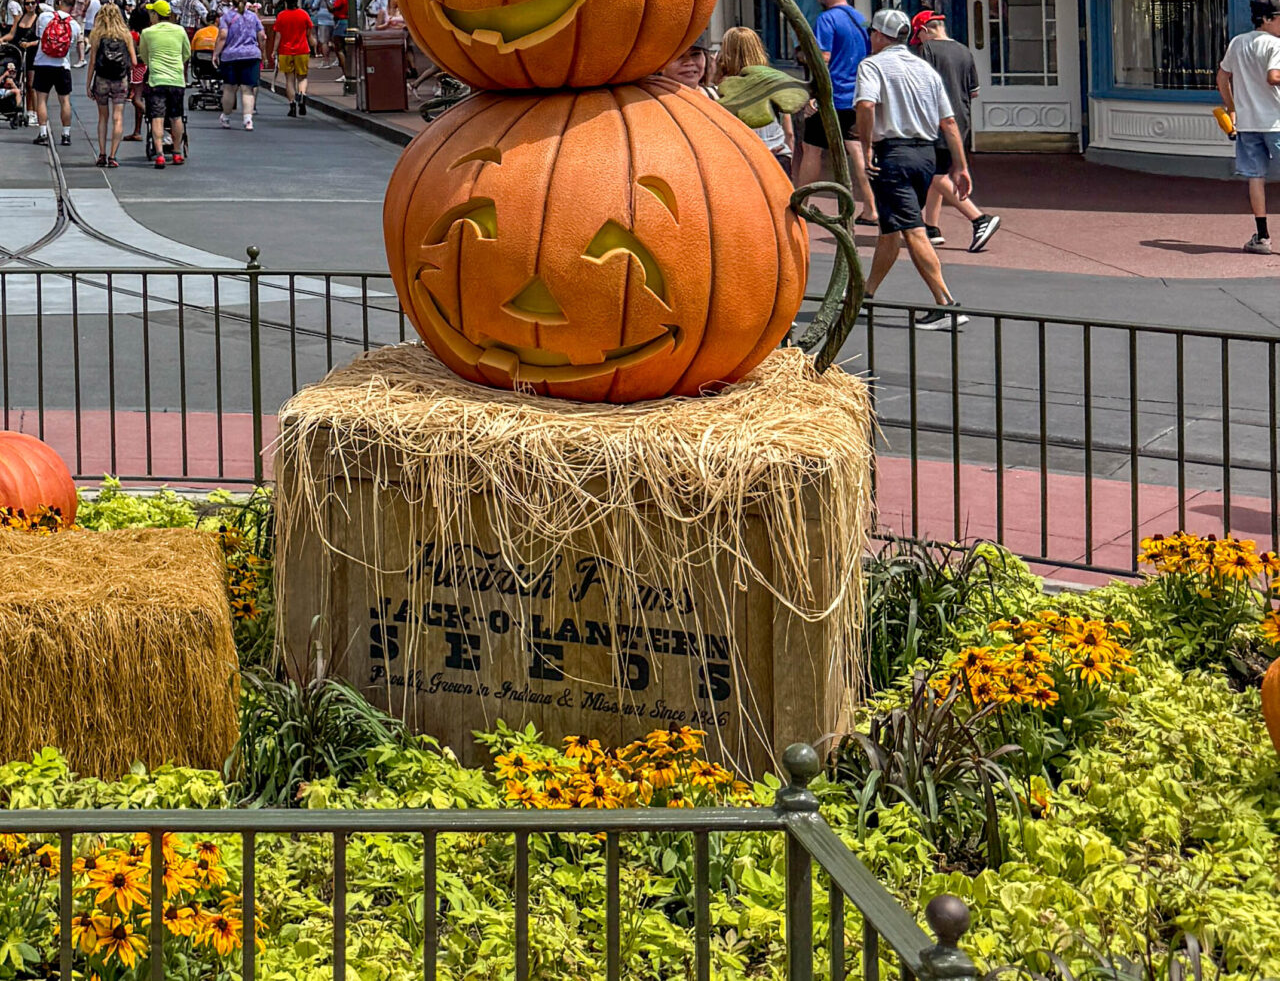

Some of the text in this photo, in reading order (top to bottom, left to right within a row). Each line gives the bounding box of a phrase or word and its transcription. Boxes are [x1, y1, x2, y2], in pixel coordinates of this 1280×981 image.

[370, 596, 730, 660] JACK-O-LANTERN
[370, 623, 731, 701] SEEDS
[429, 672, 473, 695] Grown
[476, 682, 489, 698] in
[494, 681, 553, 705] Indiana
[557, 688, 574, 708] &
[650, 699, 687, 722] Since
